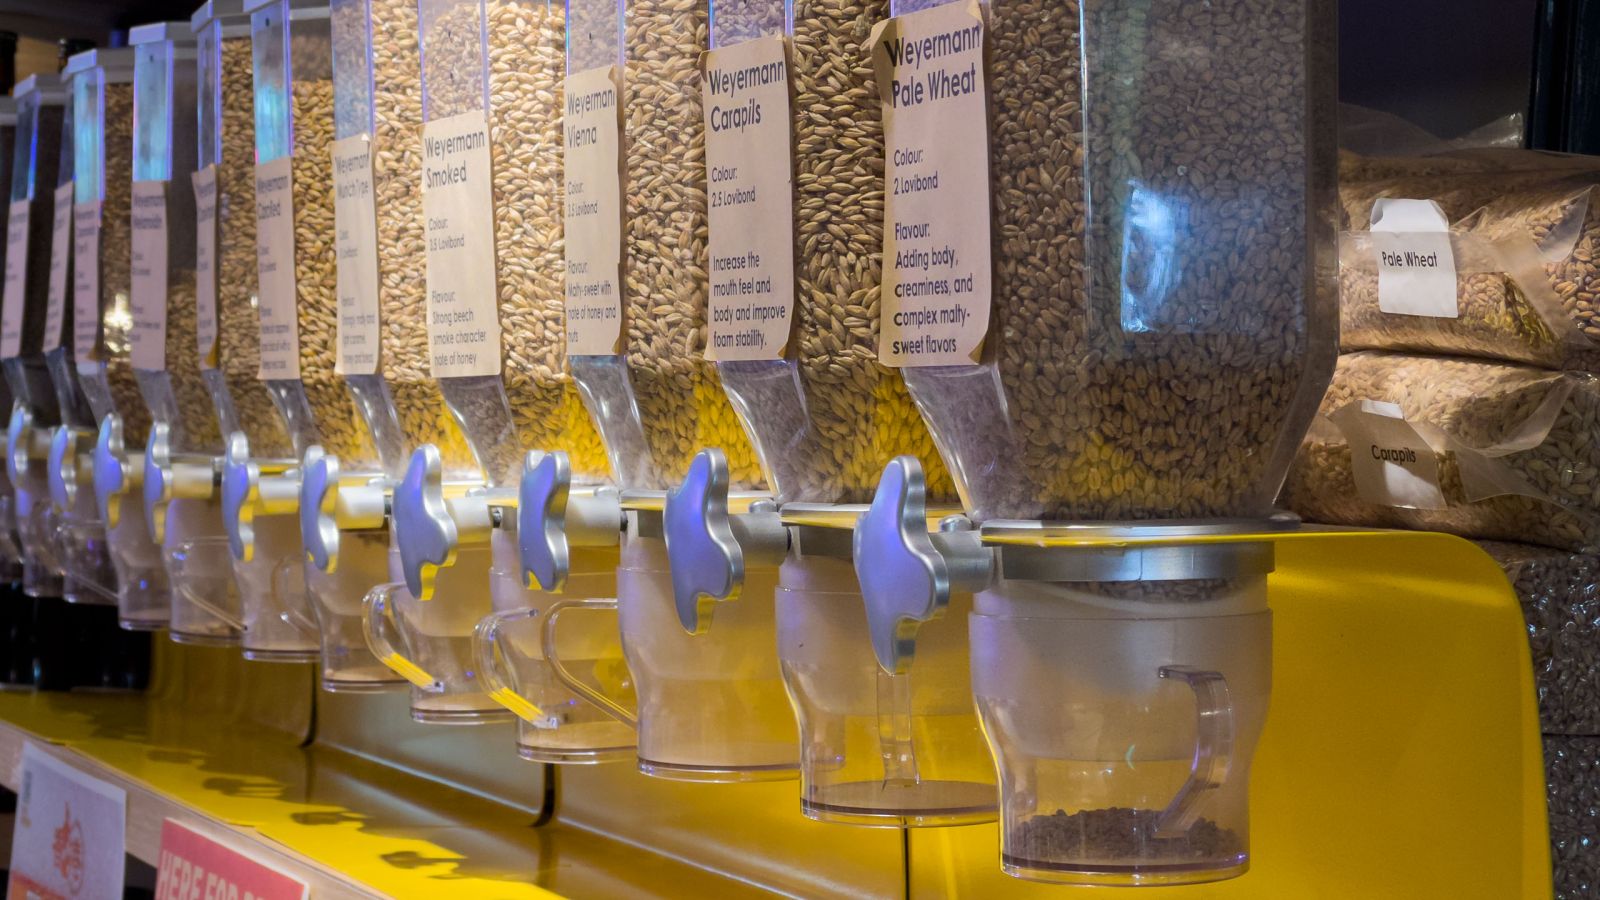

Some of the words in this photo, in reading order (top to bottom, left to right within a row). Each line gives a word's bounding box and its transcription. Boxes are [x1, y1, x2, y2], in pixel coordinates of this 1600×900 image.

[883, 25, 980, 70] Weyermann
[708, 61, 784, 98] Weyermann
[892, 76, 923, 109] Pale
[928, 62, 976, 101] Wheat
[711, 98, 761, 134] Carapils
[425, 131, 485, 160] Weyermann
[567, 123, 597, 149] Vienna
[894, 148, 924, 167] Colour:
[426, 160, 467, 188] Smoked
[711, 165, 738, 183] Colour:
[894, 177, 899, 195] 2
[901, 170, 938, 194] Lovibond
[712, 191, 722, 208] 2.5
[724, 185, 756, 207] Lovibond
[439, 233, 465, 250] Lovibond
[895, 222, 931, 241] Flavour:
[713, 256, 746, 271] Increase
[747, 251, 760, 268] the
[895, 249, 929, 271] Adding
[931, 245, 959, 269] body,
[1382, 251, 1402, 267] Pale
[1404, 251, 1438, 267] Wheat
[568, 281, 600, 298] Malty-sweet
[601, 280, 612, 296] with
[714, 279, 738, 297] mouth
[739, 277, 754, 295] feel
[755, 275, 771, 293] and
[895, 276, 952, 298] creaminess,
[954, 272, 973, 294] and
[433, 311, 452, 327] Strong
[454, 308, 474, 323] beech
[568, 305, 580, 320] note
[581, 304, 586, 319] of
[587, 304, 605, 323] honey
[605, 303, 617, 319] and
[714, 305, 734, 326] body
[736, 304, 751, 321] and
[752, 303, 786, 323] improve
[893, 306, 938, 330] complex
[940, 304, 971, 328] malty-
[434, 331, 454, 346] smoke
[713, 331, 734, 348] foam
[735, 328, 767, 350] stability.
[892, 336, 924, 355] sweet
[926, 334, 957, 354] flavors
[434, 354, 448, 367] note
[449, 352, 456, 366] of
[457, 352, 477, 368] honey
[1371, 445, 1416, 466] Carapils
[154, 850, 204, 900] HERE
